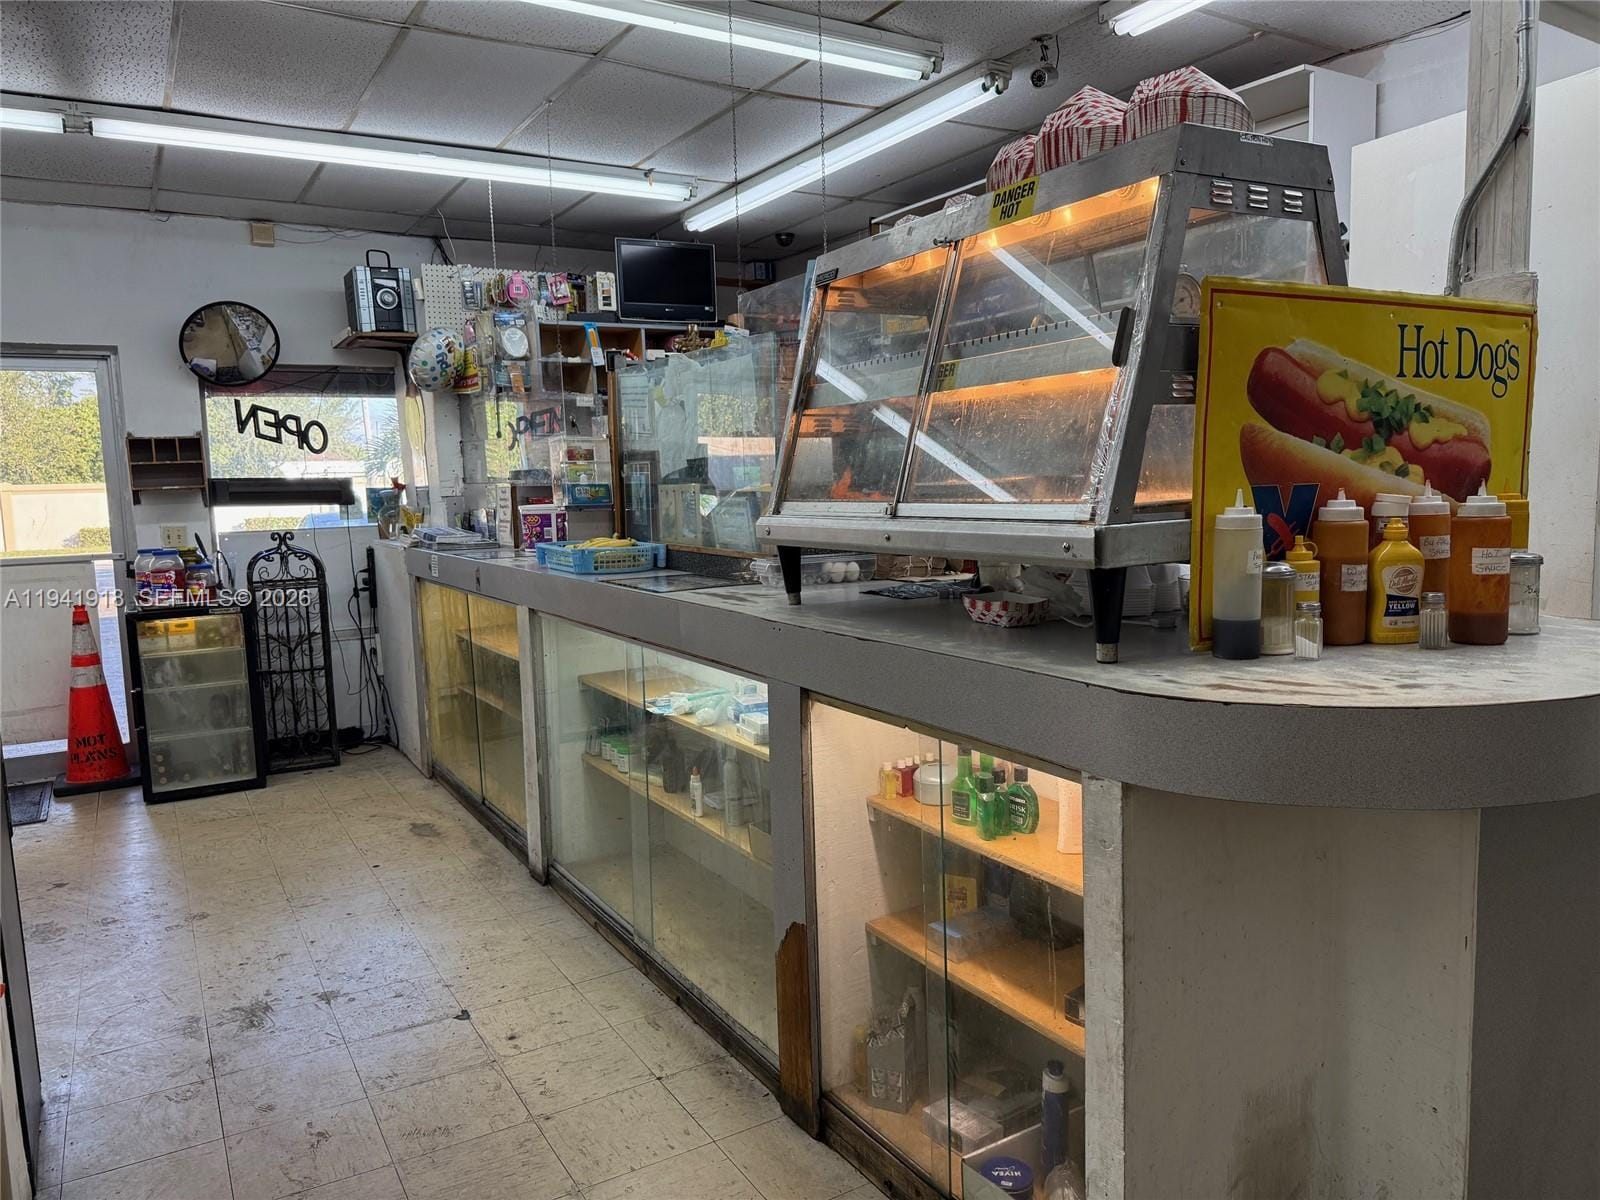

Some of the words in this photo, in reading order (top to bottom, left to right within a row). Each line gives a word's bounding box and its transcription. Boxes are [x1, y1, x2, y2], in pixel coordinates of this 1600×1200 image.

[993, 181, 1035, 208] DANGER
[1000, 200, 1022, 221] HOT
[1396, 324, 1449, 379] Hot
[1455, 327, 1519, 398] Dogs
[1389, 602, 1416, 611] YELLOW
